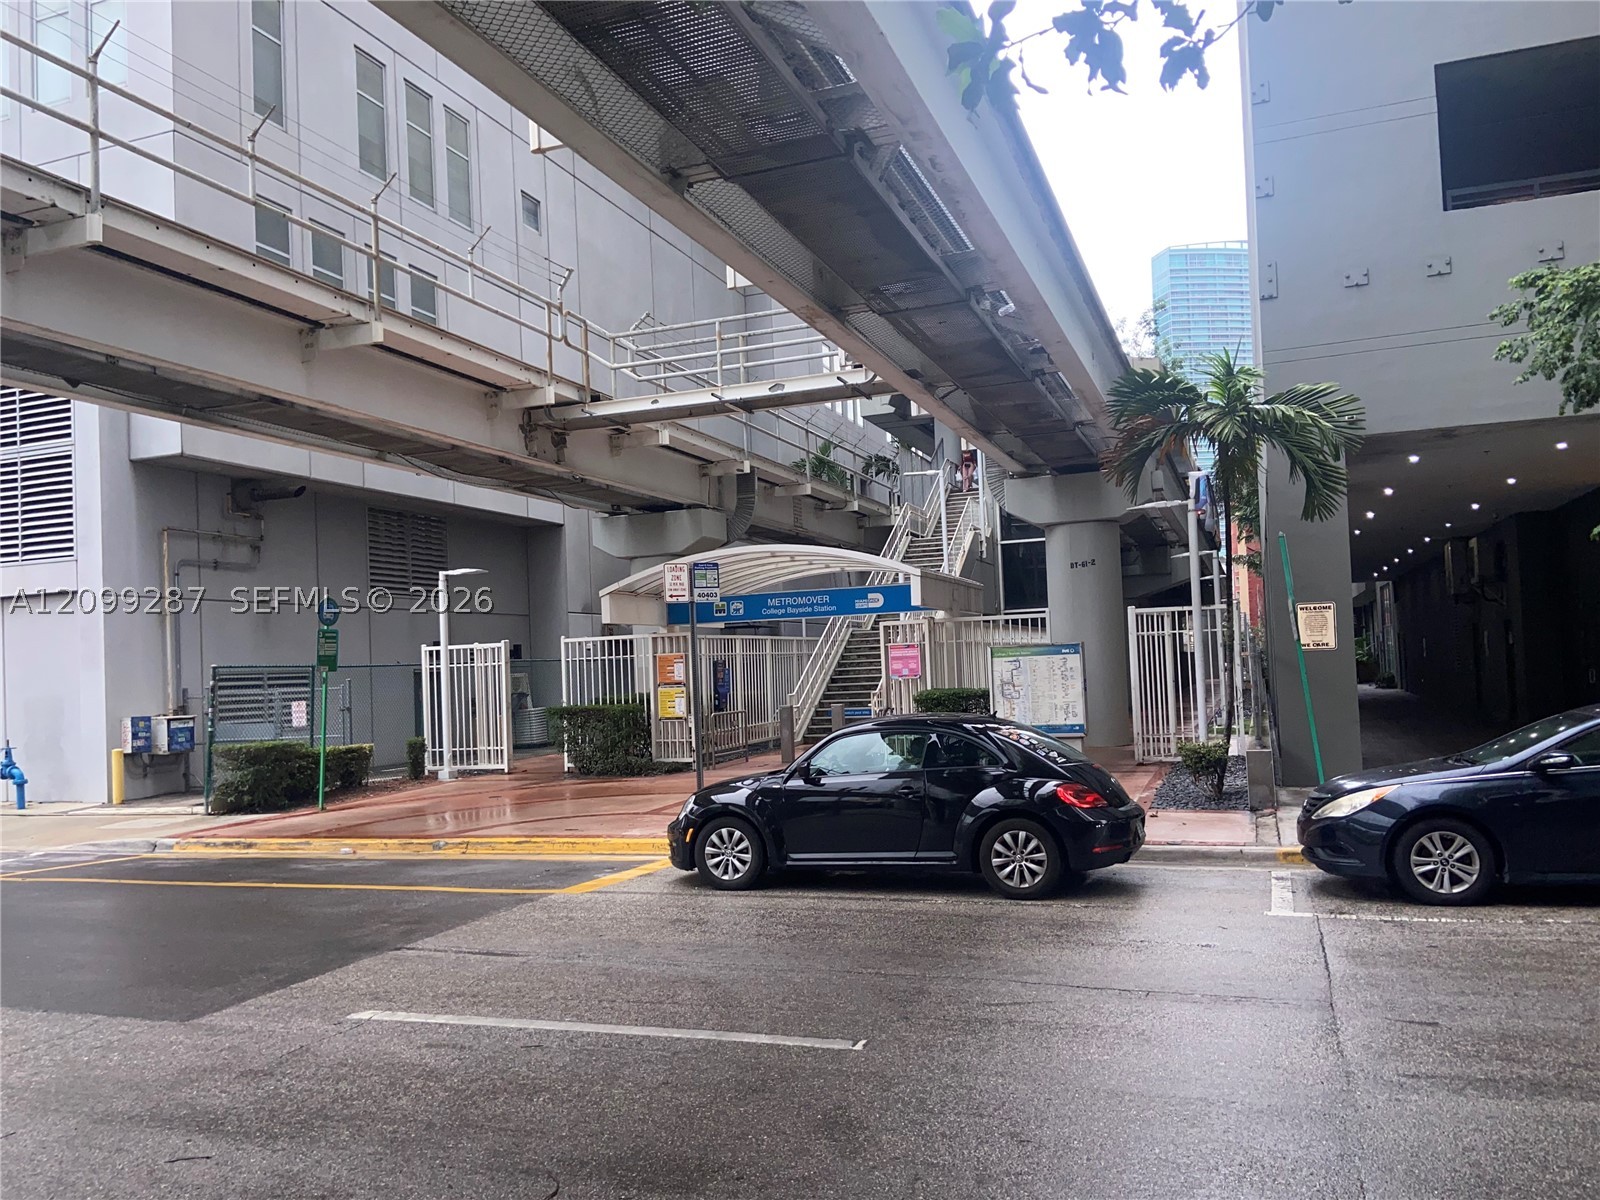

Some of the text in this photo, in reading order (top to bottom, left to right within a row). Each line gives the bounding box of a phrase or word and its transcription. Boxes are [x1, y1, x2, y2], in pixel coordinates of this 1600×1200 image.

[767, 595, 830, 607] METROMOVER
[761, 604, 837, 615] College Bayside Station
